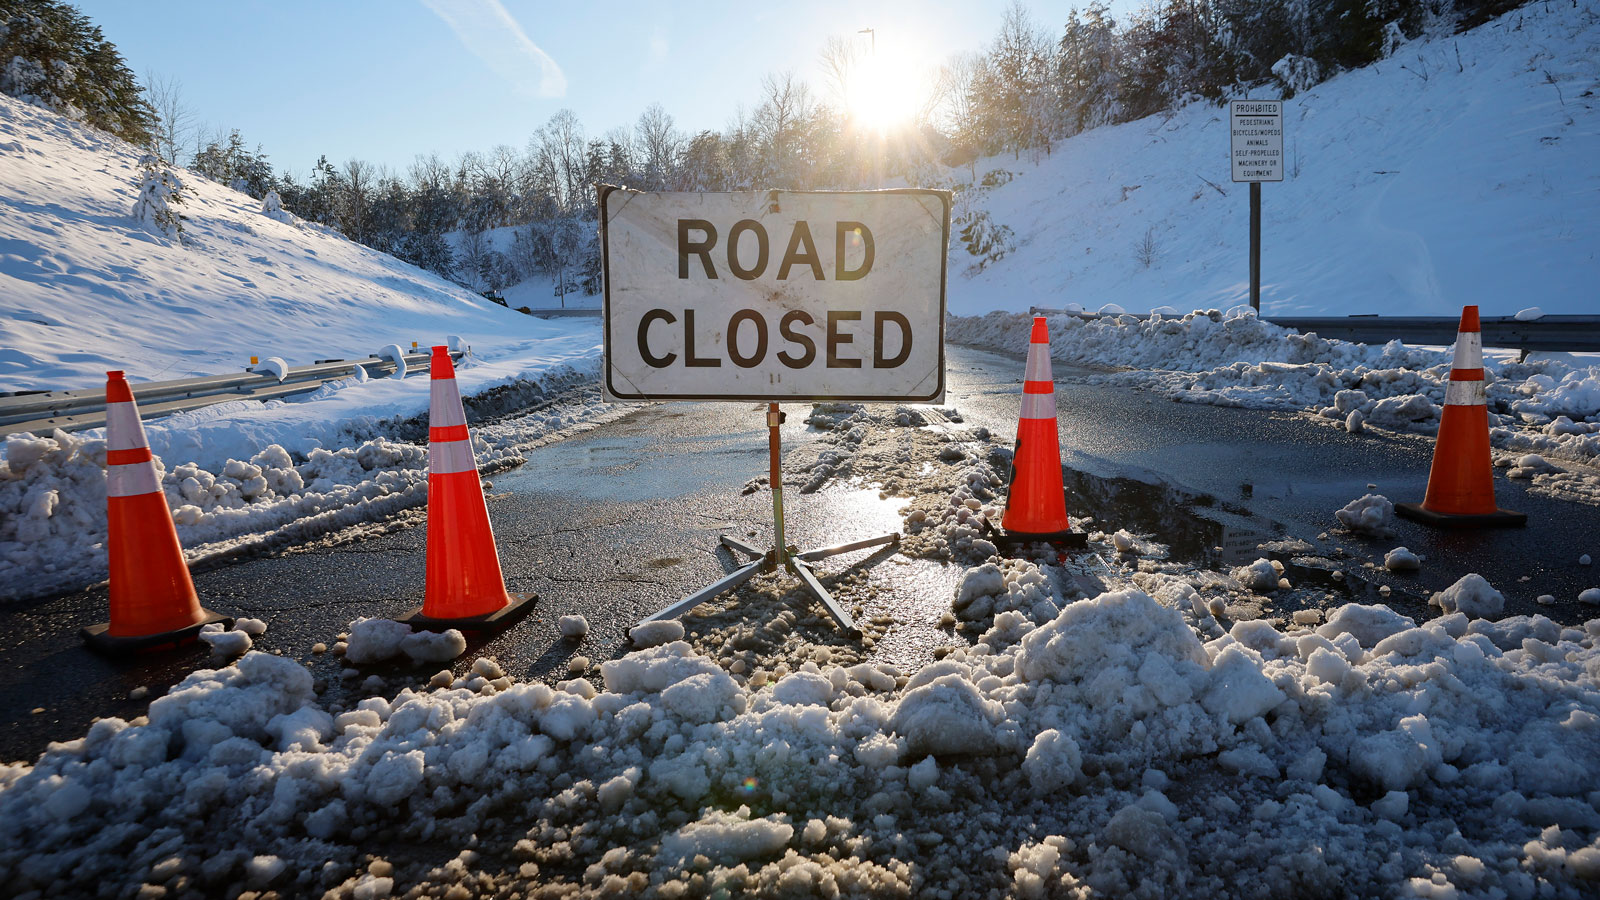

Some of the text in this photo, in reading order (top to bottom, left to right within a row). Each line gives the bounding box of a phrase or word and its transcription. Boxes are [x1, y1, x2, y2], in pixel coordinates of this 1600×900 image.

[1236, 104, 1278, 112] PROHIBITED
[1235, 149, 1280, 157] SELF-PROPELLED
[677, 219, 875, 281] ROAD
[636, 308, 913, 370] CLOSED
